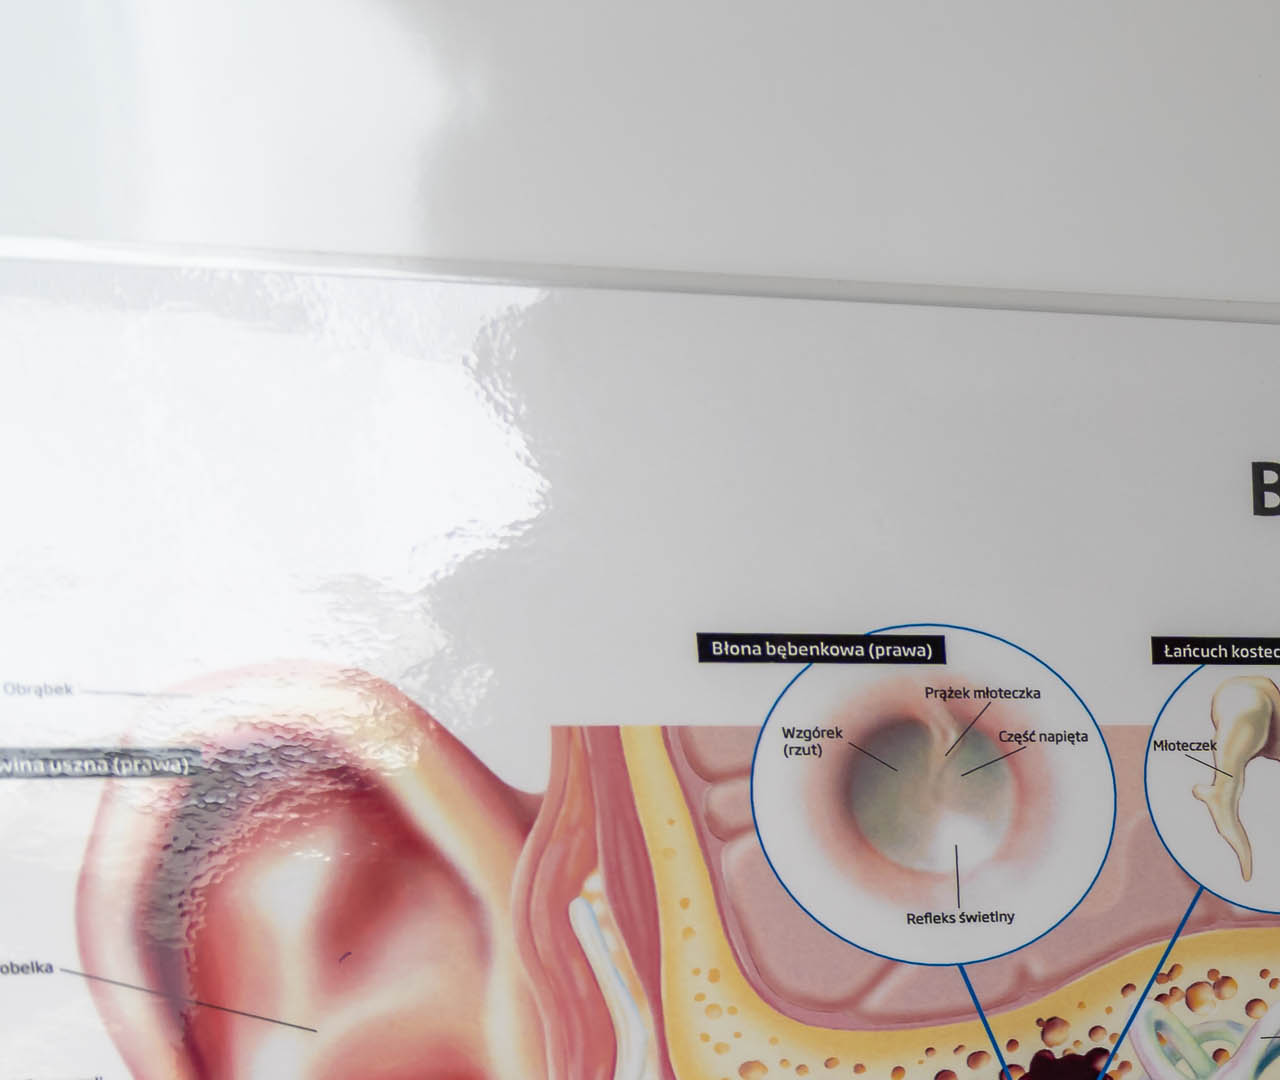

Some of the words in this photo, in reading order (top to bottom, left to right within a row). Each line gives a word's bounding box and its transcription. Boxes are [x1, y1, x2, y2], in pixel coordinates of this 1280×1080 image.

[711, 640, 762, 656] Błona
[766, 641, 865, 659] bębenkowa
[868, 642, 933, 660] (prawa)
[1164, 643, 1228, 658] Łańcuch
[3, 682, 74, 698] Obrąbek
[924, 686, 971, 703] Prążek
[973, 686, 1041, 700] młoteczka
[782, 725, 843, 743] Wzgórek
[999, 729, 1036, 745] Część
[1038, 729, 1089, 745] napięta
[783, 743, 823, 759] (rzut)
[1153, 739, 1217, 752] Młoteczek
[906, 912, 956, 925] Refleks
[959, 910, 1015, 925] świetlny
